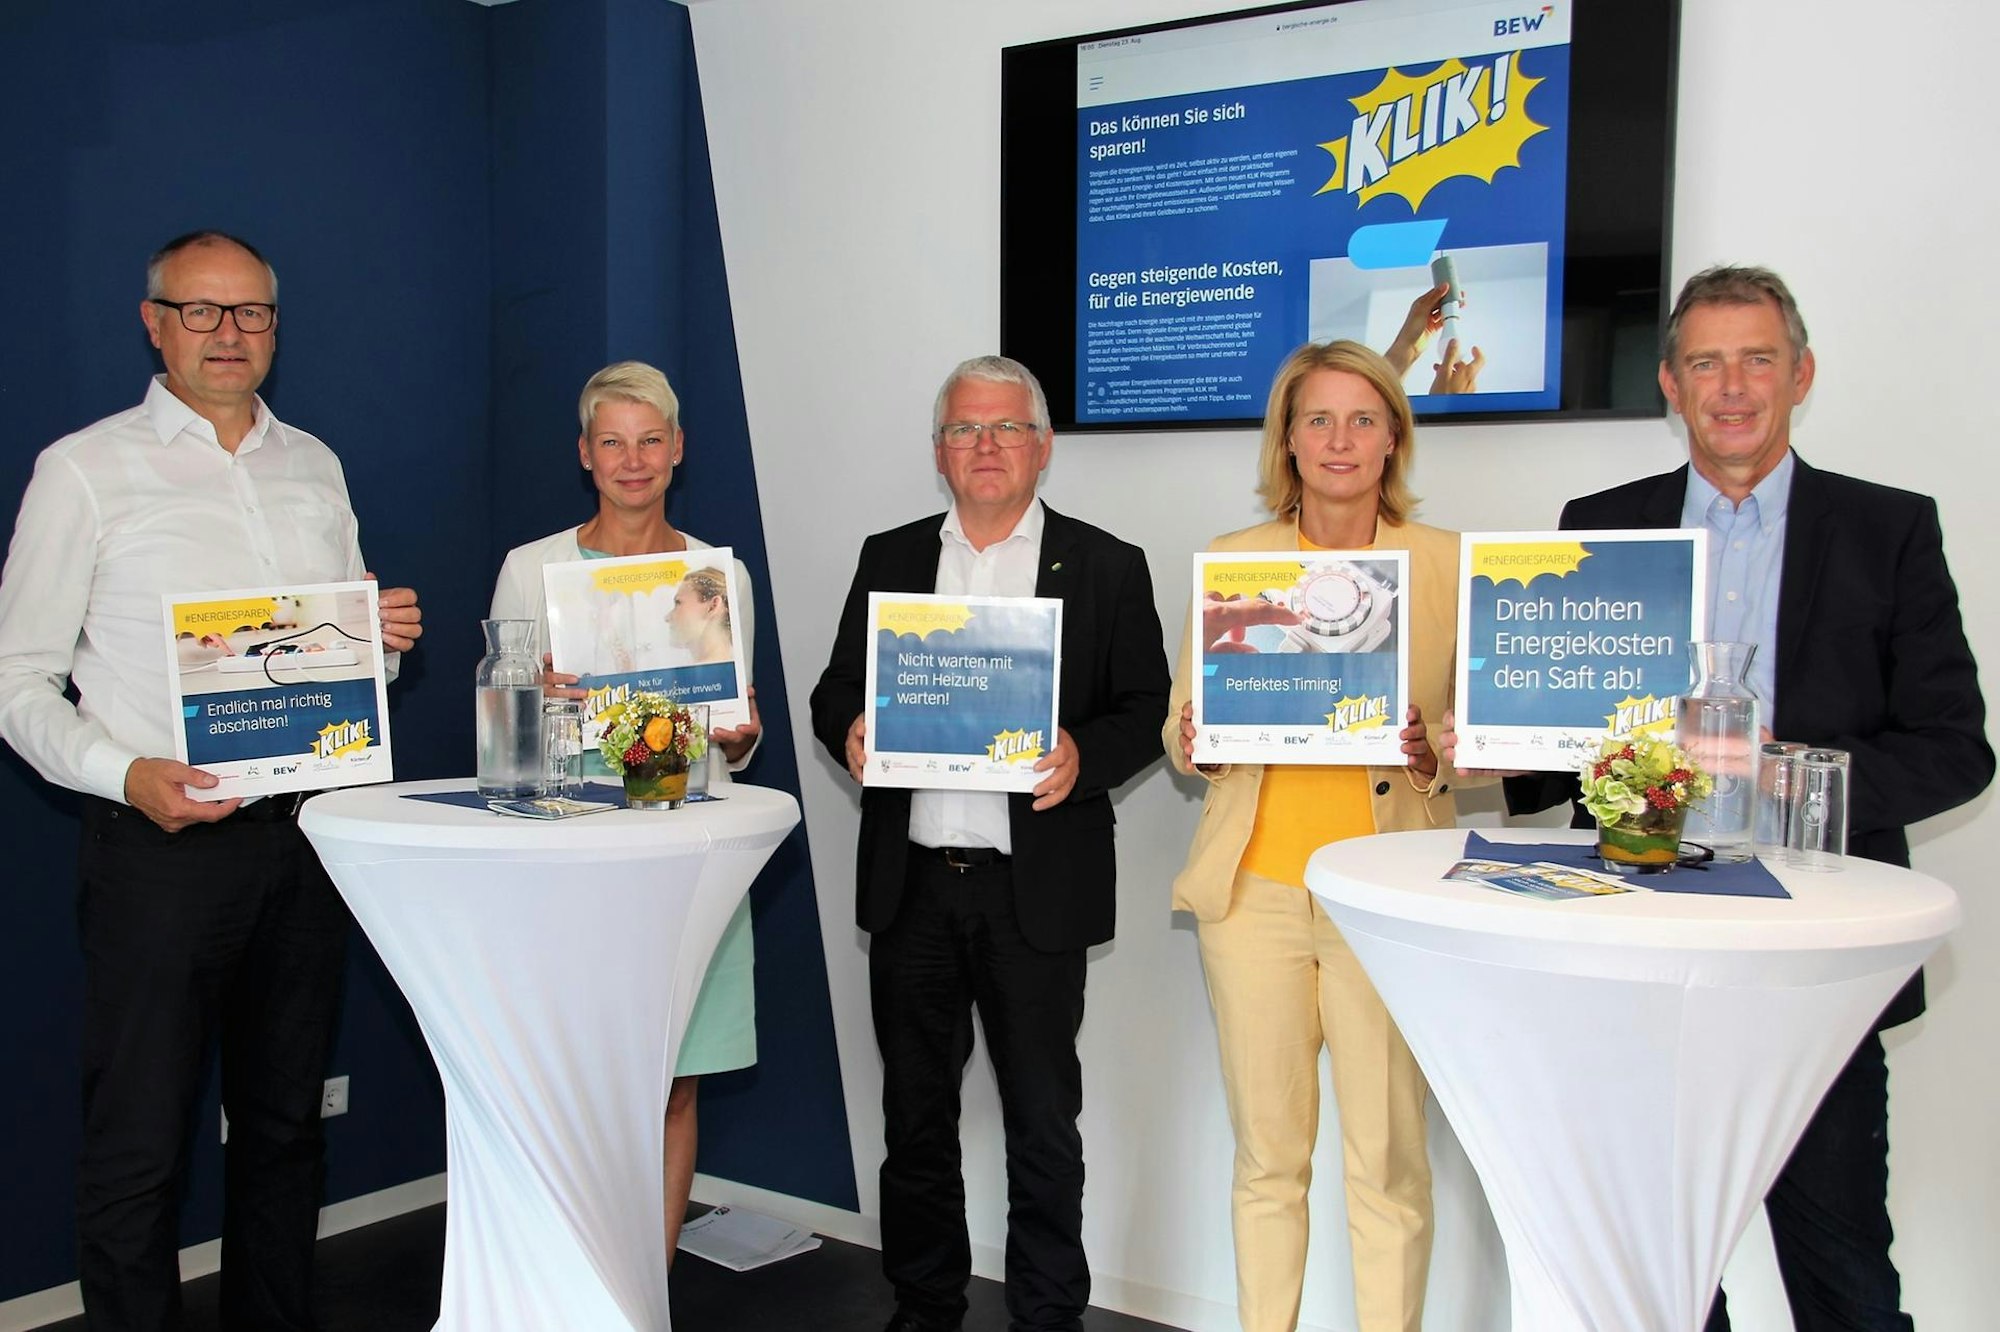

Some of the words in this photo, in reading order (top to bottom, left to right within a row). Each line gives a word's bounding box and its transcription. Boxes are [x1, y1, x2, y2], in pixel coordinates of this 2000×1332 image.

[1493, 14, 1545, 37] BEW
[1090, 121, 1118, 137] Das
[1122, 111, 1180, 132] können
[1184, 106, 1208, 126] Sie
[1212, 102, 1246, 121] sich
[1347, 53, 1510, 194] KLIK!
[1089, 138, 1146, 161] sparen!
[1088, 270, 1137, 290] Gegen
[1140, 264, 1218, 284] steigende
[1222, 259, 1283, 280] Kosten,
[1088, 292, 1113, 310] für
[1115, 290, 1138, 308] die
[1141, 284, 1255, 309] Energiewende
[1483, 554, 1577, 566] #ENERGIESPAREN
[1213, 572, 1297, 583] #ENERGIESPAREN
[185, 608, 271, 624] #ENERGIESPAREN
[1496, 597, 1553, 621] Dreh
[1562, 596, 1641, 621] hohen
[1495, 631, 1672, 660] Energiekosten
[898, 652, 934, 668] Nicht
[937, 656, 986, 670] warten
[990, 655, 1013, 670] mit
[638, 680, 650, 688] Nix
[652, 678, 663, 686] für
[897, 672, 928, 686] dem
[932, 673, 989, 691] Heizung
[1226, 677, 1290, 692] Perfektes
[1292, 677, 1342, 694] Timing!
[1493, 664, 1539, 689] den
[1548, 665, 1596, 690] Saft
[1603, 666, 1642, 690] ab!
[207, 698, 258, 717] Endlich
[261, 696, 286, 712] mal
[290, 691, 333, 709] richtig
[583, 683, 630, 723] KLIK!
[897, 692, 950, 706] warten!
[208, 714, 289, 735] abschalten!
[1333, 695, 1388, 733] KLIK!
[1614, 695, 1677, 737] KLIK!
[319, 718, 369, 760] KLIK!
[992, 730, 1044, 763] KLIK!
[1284, 736, 1309, 745] BEW
[1558, 739, 1586, 749] BEW
[273, 765, 298, 776] BEW
[948, 763, 972, 772] BEW
